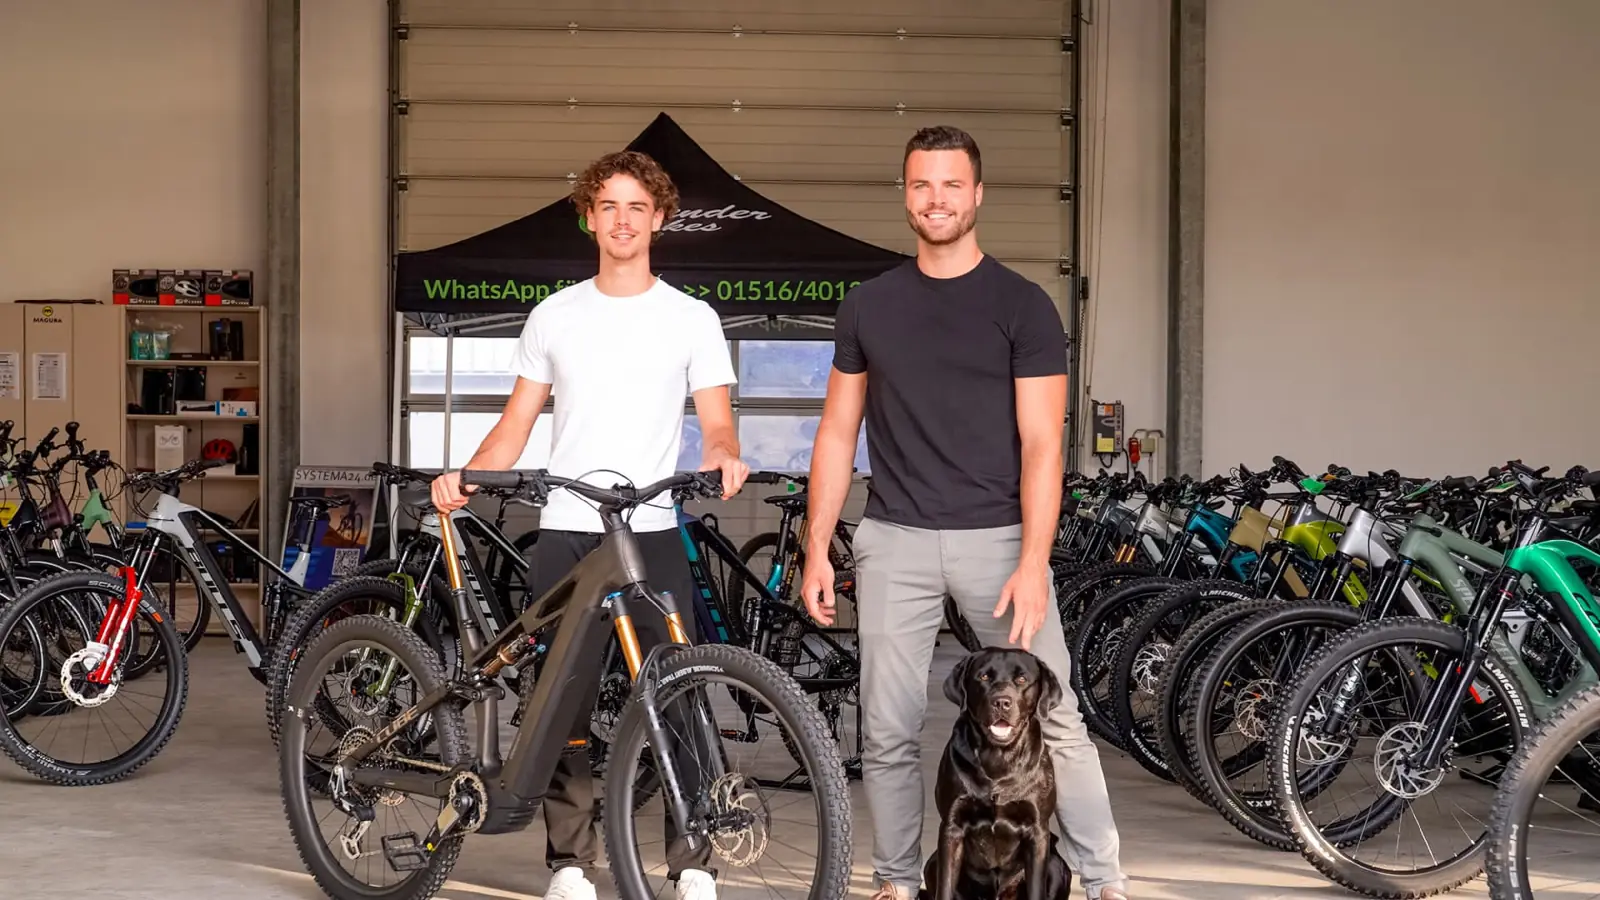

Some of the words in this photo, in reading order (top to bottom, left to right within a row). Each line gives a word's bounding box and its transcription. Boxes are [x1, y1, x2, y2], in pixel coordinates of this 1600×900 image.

[662, 218, 722, 232] kes
[423, 279, 550, 304] WhatsApp
[1491, 667, 1530, 729] MICHELIN
[376, 705, 419, 743] CUBE
[4, 728, 36, 760] MAGIC
[36, 758, 74, 775] MARY
[1134, 738, 1169, 770] MICHELIN
[1282, 726, 1293, 795] MICHELIN
